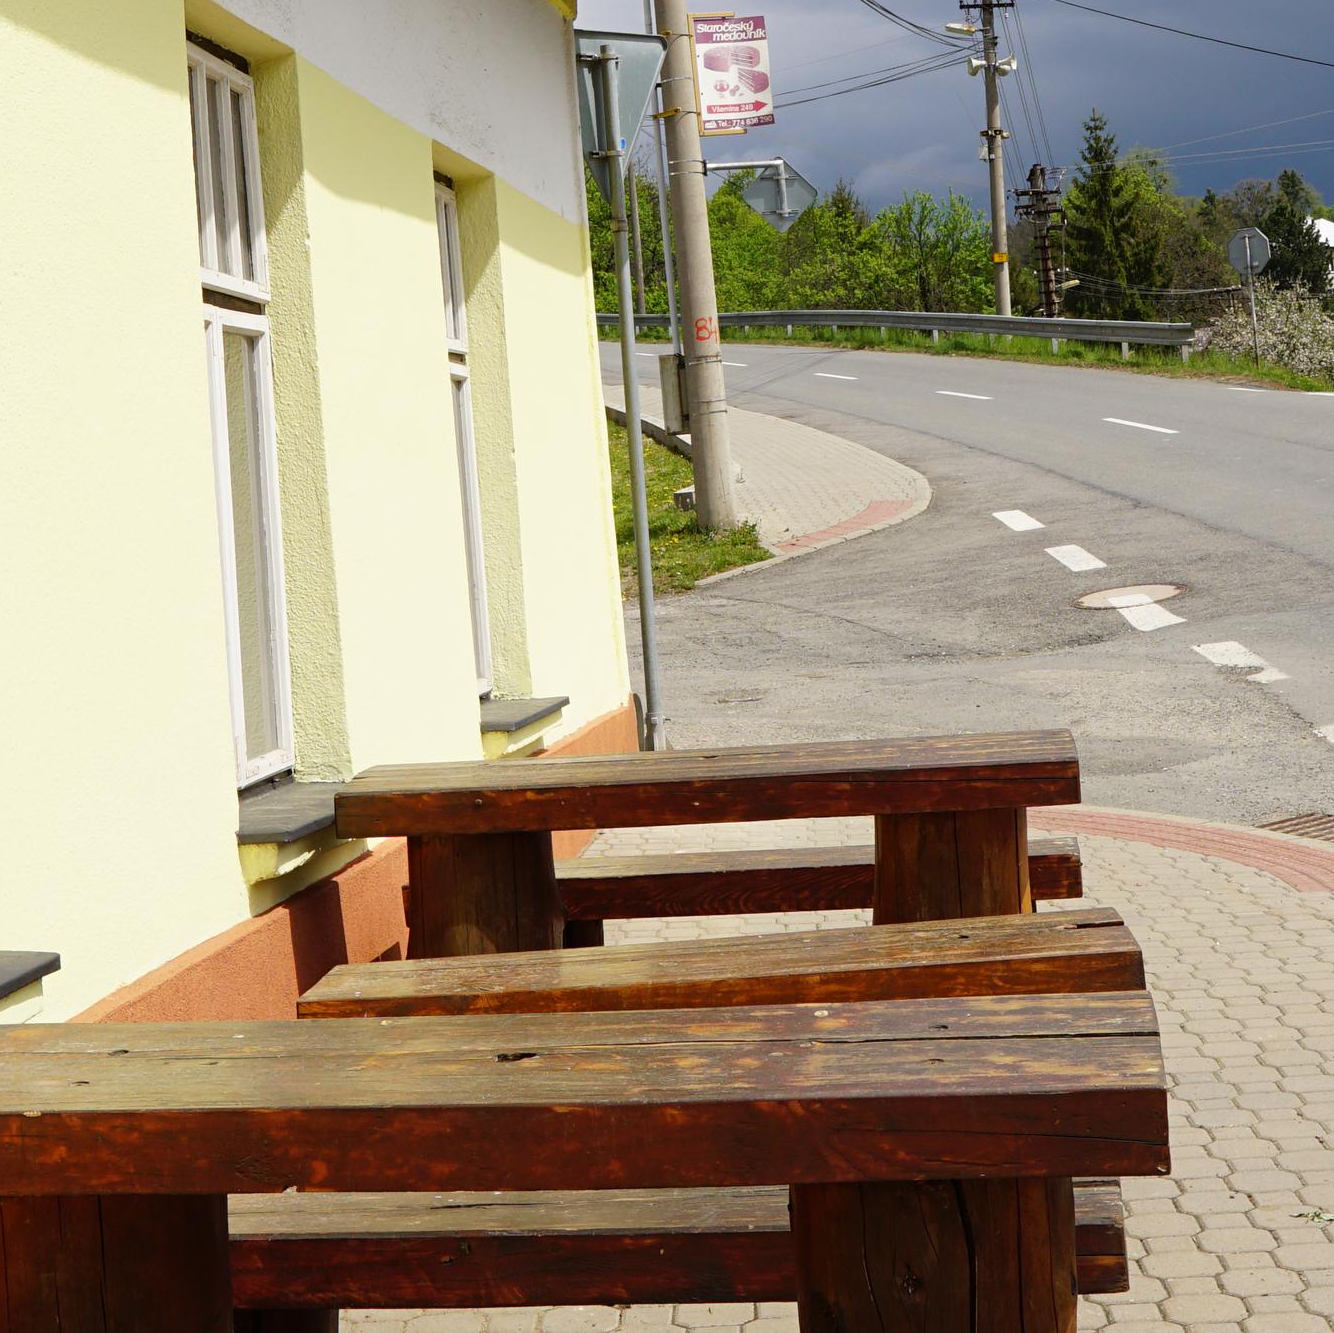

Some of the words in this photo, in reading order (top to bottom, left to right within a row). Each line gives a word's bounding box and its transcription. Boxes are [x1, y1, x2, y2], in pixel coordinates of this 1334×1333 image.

[697, 20, 754, 33] Staročeský
[713, 28, 766, 41] medovník
[732, 119, 745, 127] 774
[759, 115, 773, 123] 290
